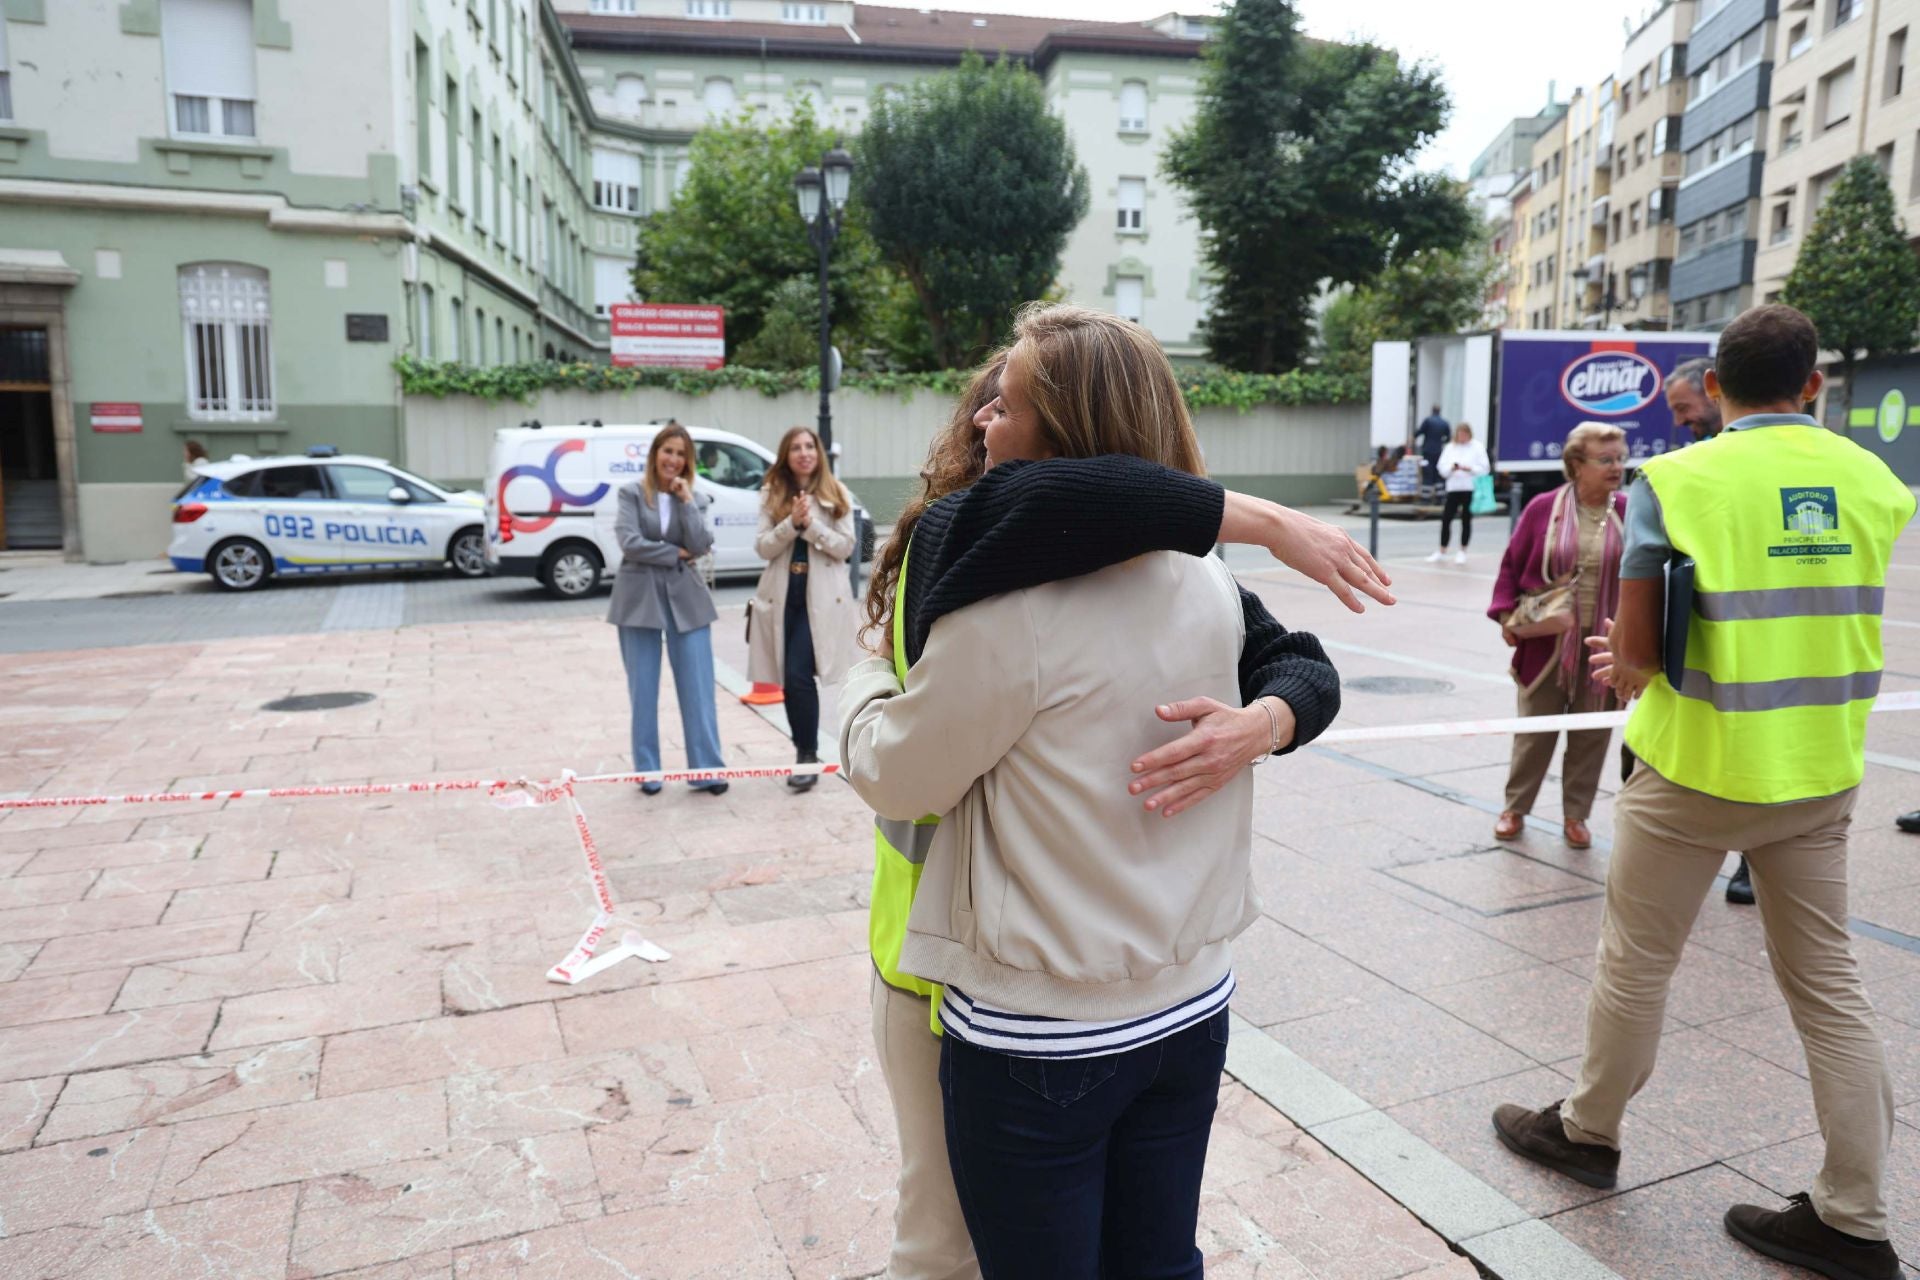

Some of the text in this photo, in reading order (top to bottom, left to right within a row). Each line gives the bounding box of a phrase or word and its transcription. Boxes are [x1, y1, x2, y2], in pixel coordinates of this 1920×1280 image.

[616, 307, 719, 320] COLEGIO CONCERTADO
[617, 321, 643, 332] DULCE
[646, 323, 679, 333] NOMBRE
[681, 323, 692, 333] DE
[1570, 362, 1649, 398] elmar
[1788, 491, 1829, 503] AUDITORIO
[264, 514, 315, 539] 092
[1817, 535, 1839, 543] FELIPE
[1769, 545, 1851, 556] PALACIO DE CONGRESOS
[1796, 557, 1828, 565] OVIEDO
